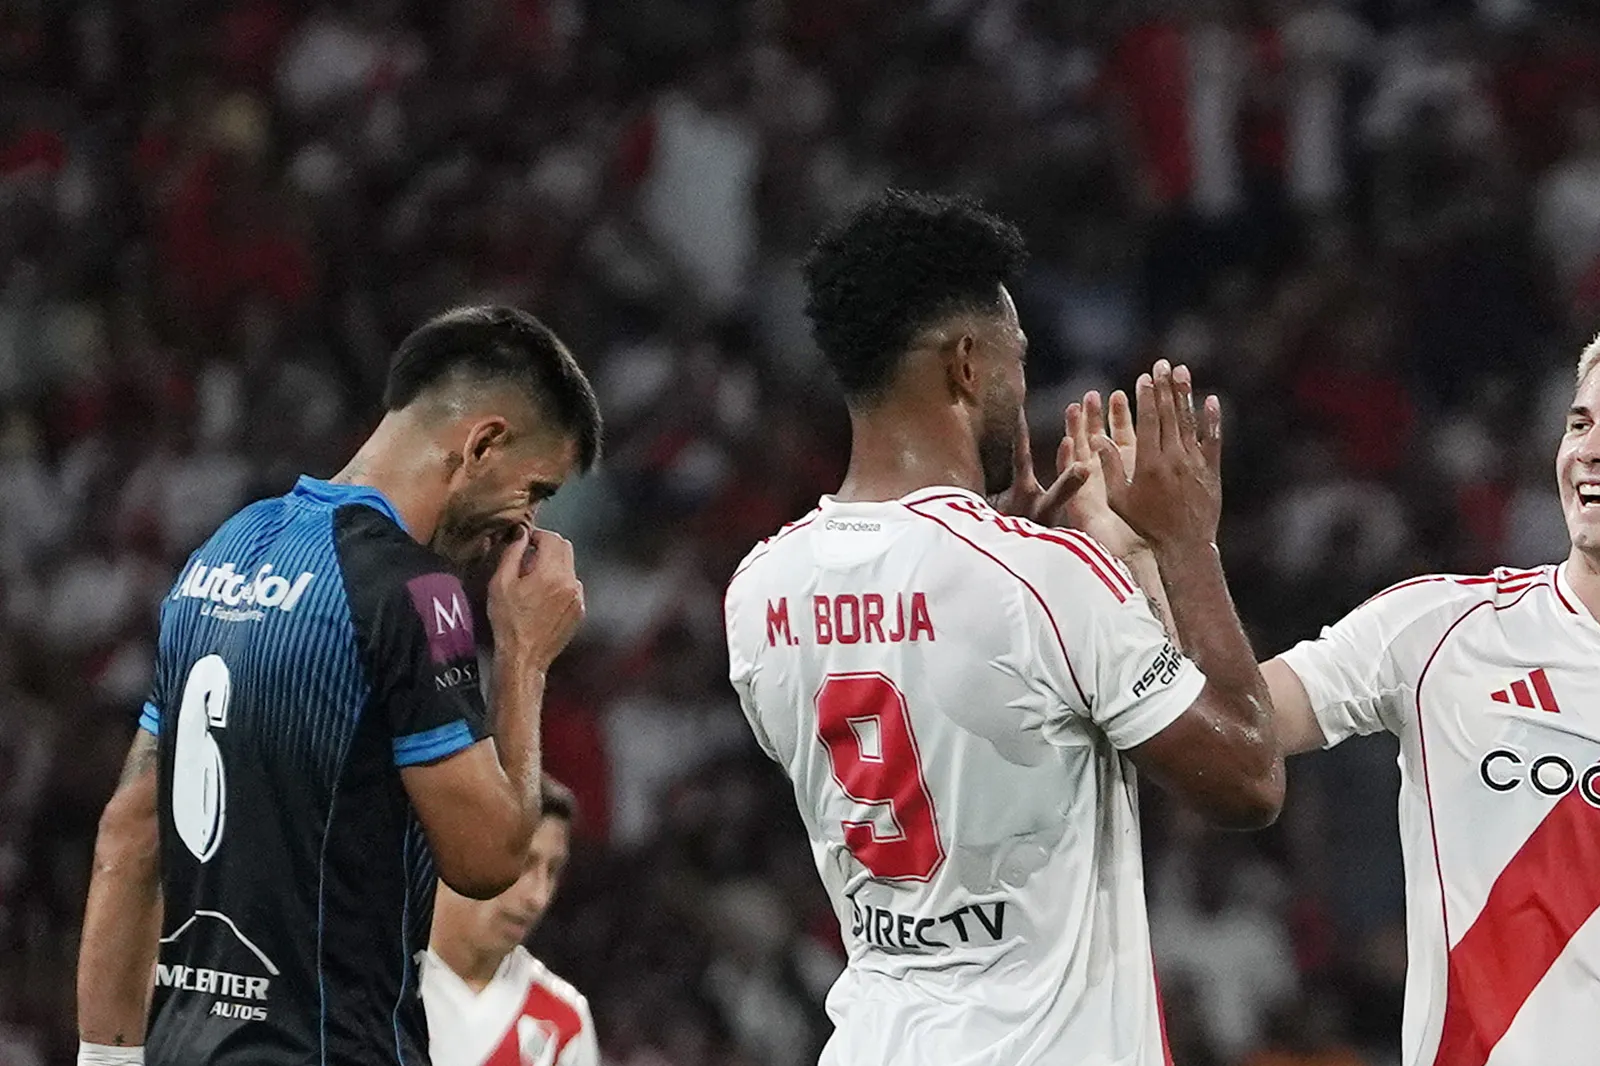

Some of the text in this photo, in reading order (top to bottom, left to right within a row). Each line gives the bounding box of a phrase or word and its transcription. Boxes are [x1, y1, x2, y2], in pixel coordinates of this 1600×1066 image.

[433, 593, 469, 635] M
[766, 592, 935, 647] M. BORJA
[1160, 650, 1183, 685] CAR
[172, 653, 231, 864] 6
[814, 671, 947, 883] 9
[209, 1001, 269, 1022] AUTOS
